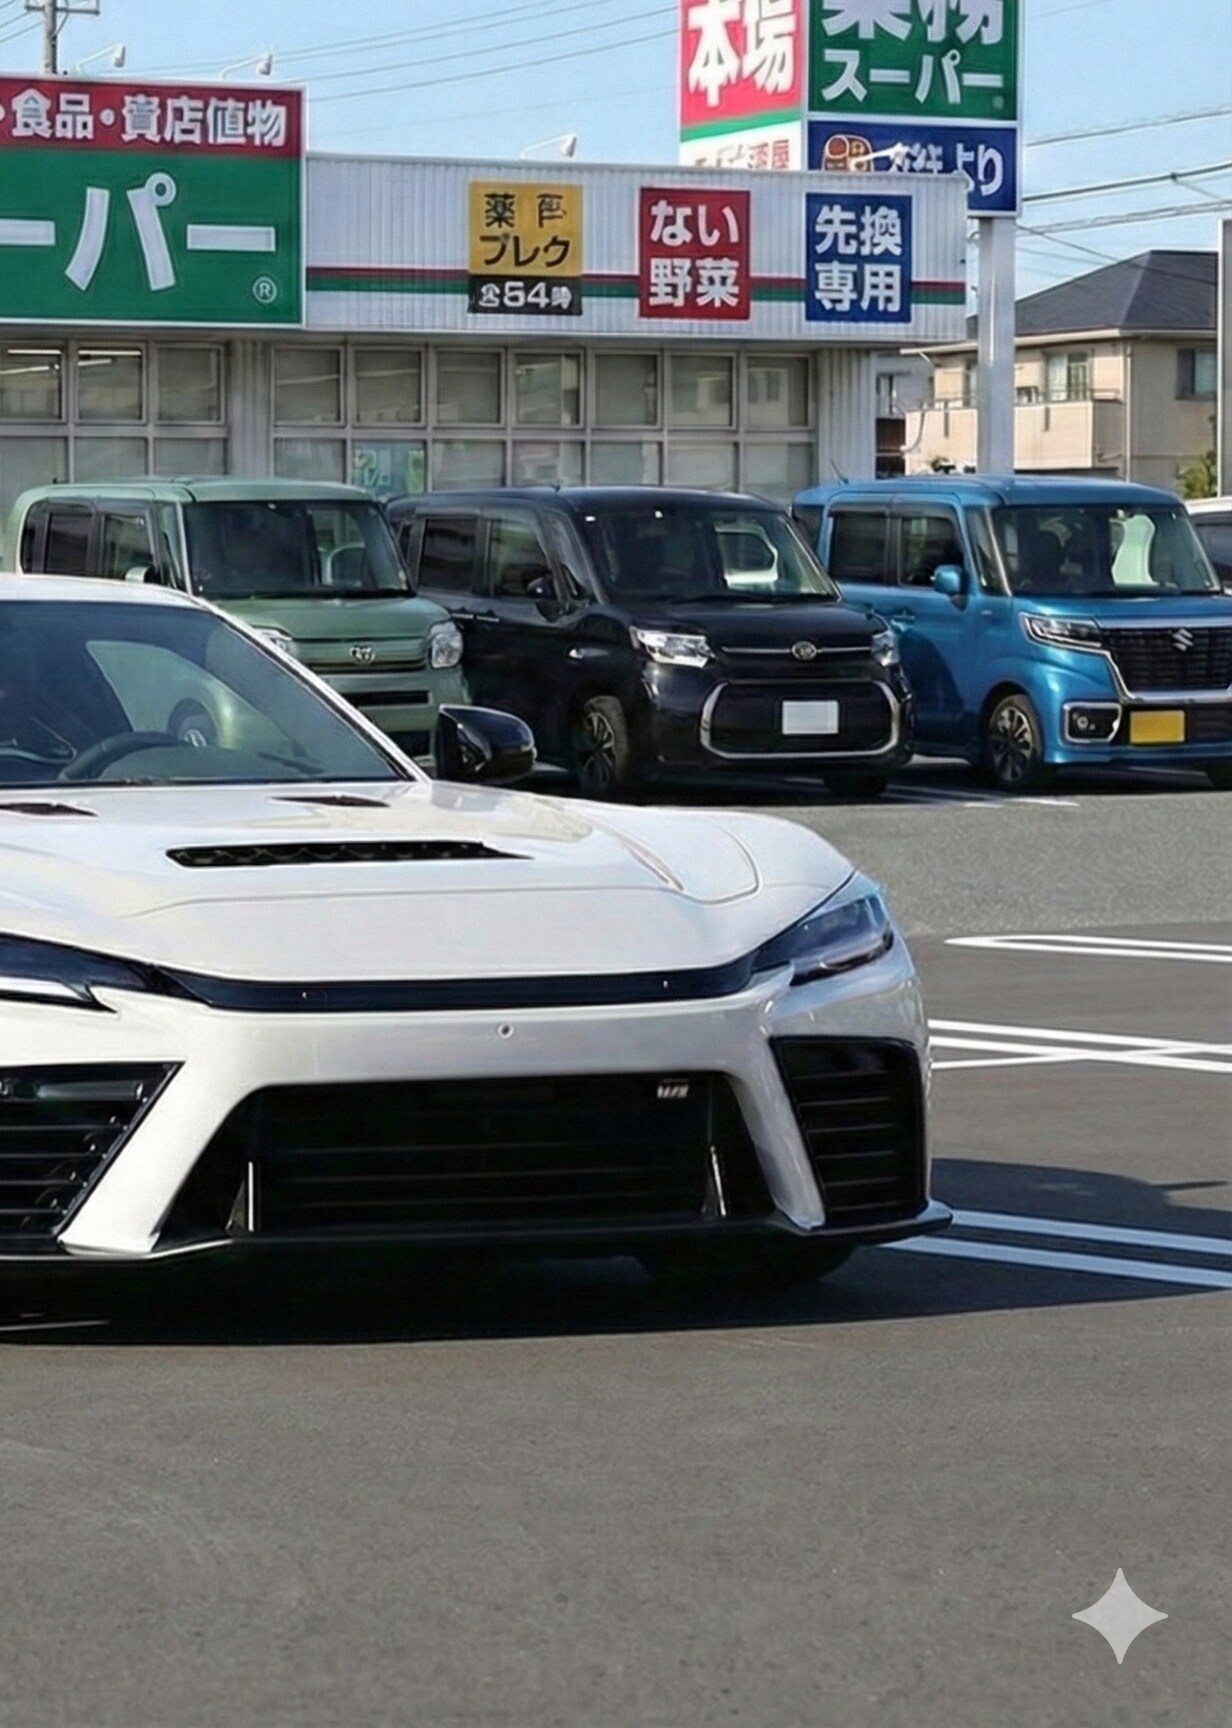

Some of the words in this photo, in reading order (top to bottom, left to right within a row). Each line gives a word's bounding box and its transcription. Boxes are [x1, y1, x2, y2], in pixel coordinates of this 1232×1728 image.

[821, 49, 1004, 104] スーパー
[649, 200, 740, 246] ない
[649, 257, 740, 308] 野菜
[814, 261, 903, 312] 専用
